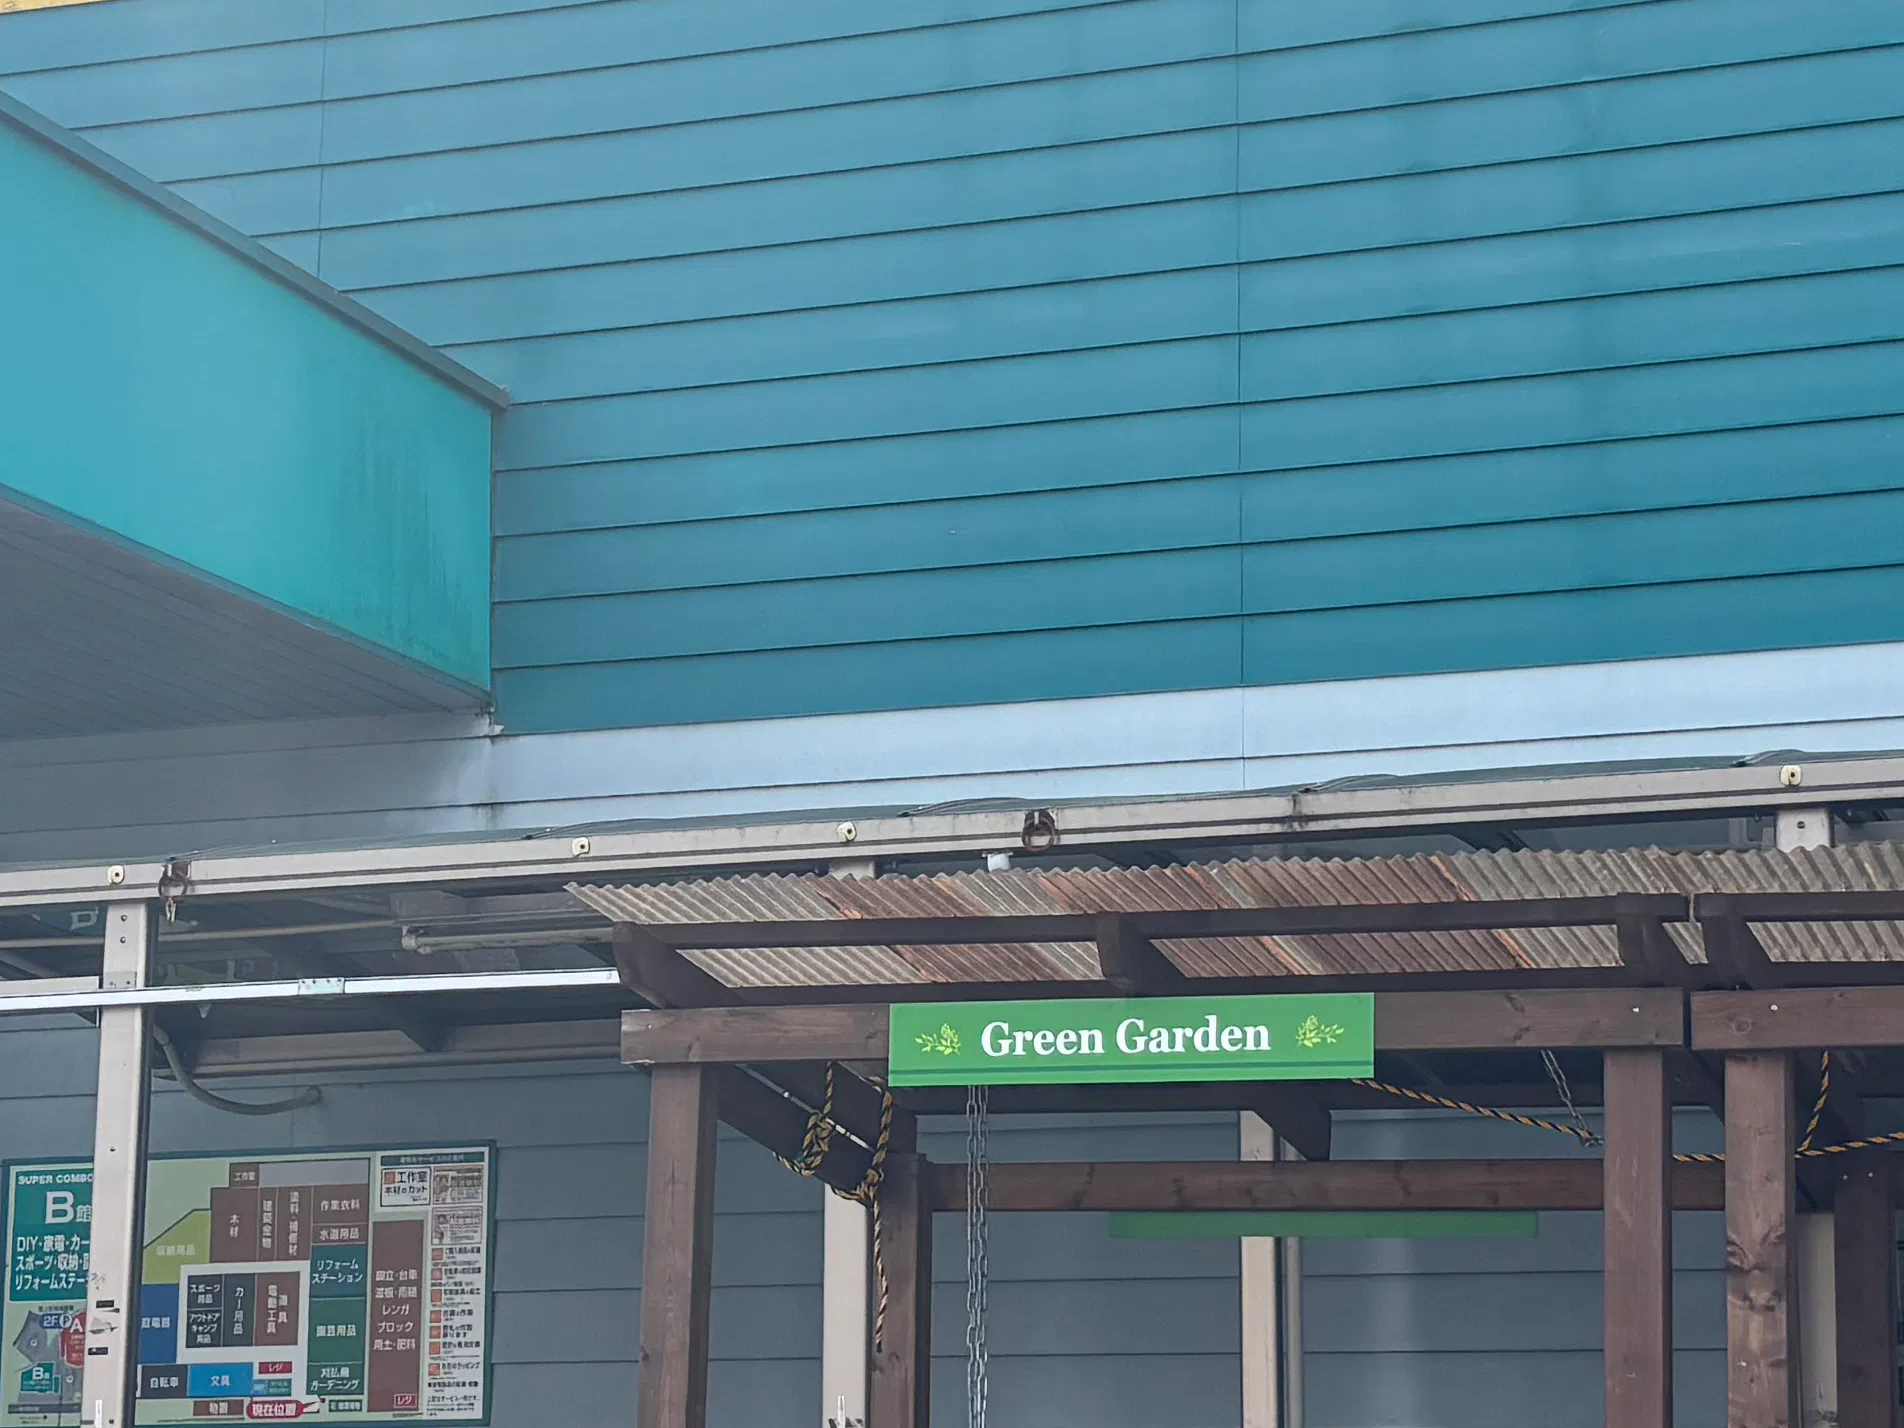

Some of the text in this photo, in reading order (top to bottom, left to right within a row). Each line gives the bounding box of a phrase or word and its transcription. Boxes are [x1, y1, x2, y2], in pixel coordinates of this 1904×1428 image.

[981, 1015, 1271, 1057] Green Garden
[18, 1175, 53, 1184] SUPER
[397, 1171, 427, 1183] 工作室
[317, 1259, 359, 1271] リフォーム
[16, 1273, 88, 1290] リフォームステー
[312, 1273, 363, 1284] ステーション
[190, 1284, 220, 1293] スポーツ
[383, 1304, 410, 1315] レンガ
[377, 1322, 413, 1333] ブロック
[211, 1375, 230, 1386] 文具
[252, 1404, 296, 1416] 現在位置
